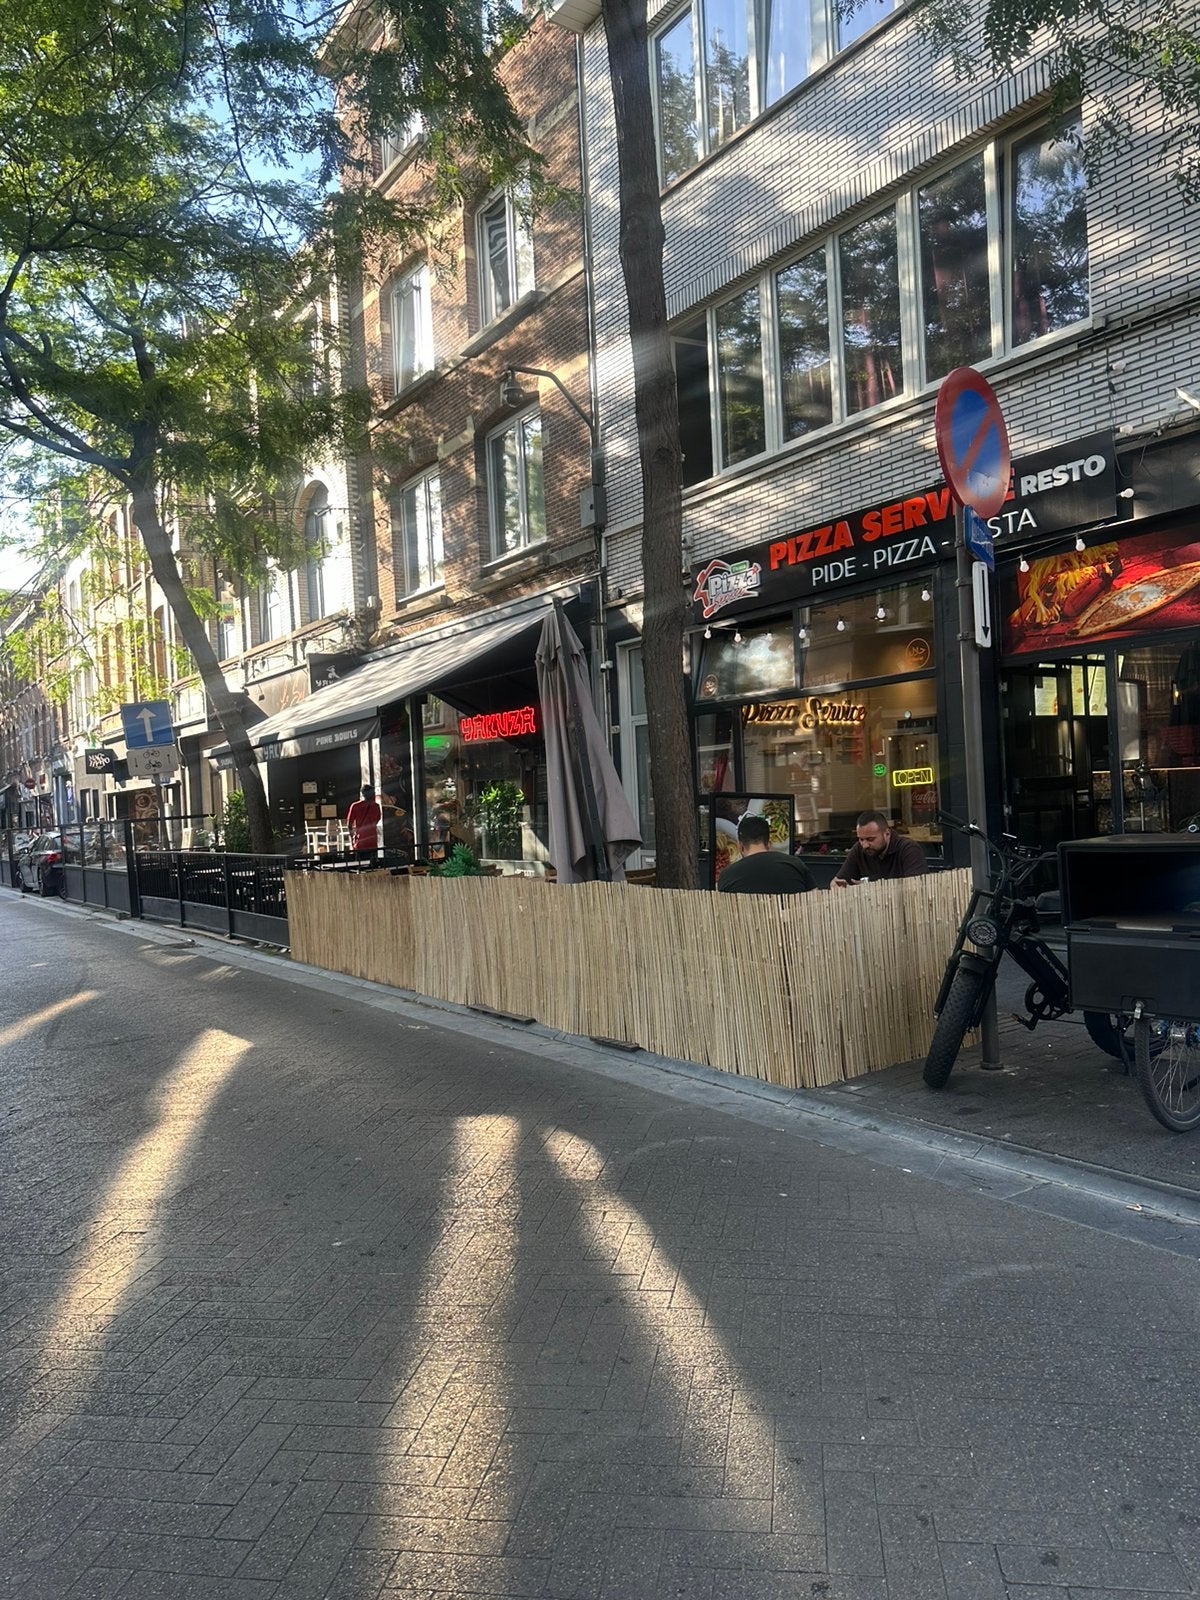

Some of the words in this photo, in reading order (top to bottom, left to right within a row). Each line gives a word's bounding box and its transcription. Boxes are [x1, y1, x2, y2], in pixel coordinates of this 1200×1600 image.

[768, 520, 855, 571] PIZZA
[861, 468, 1016, 542] SERV
[1020, 454, 1106, 497] RESTO
[811, 556, 857, 587] PIDE
[873, 535, 937, 570] PIZZA
[986, 508, 1038, 539] STA
[708, 568, 759, 598] Pizza
[461, 706, 536, 742] YAKUZA
[799, 696, 867, 731] Service
[898, 770, 929, 784] OPEN
